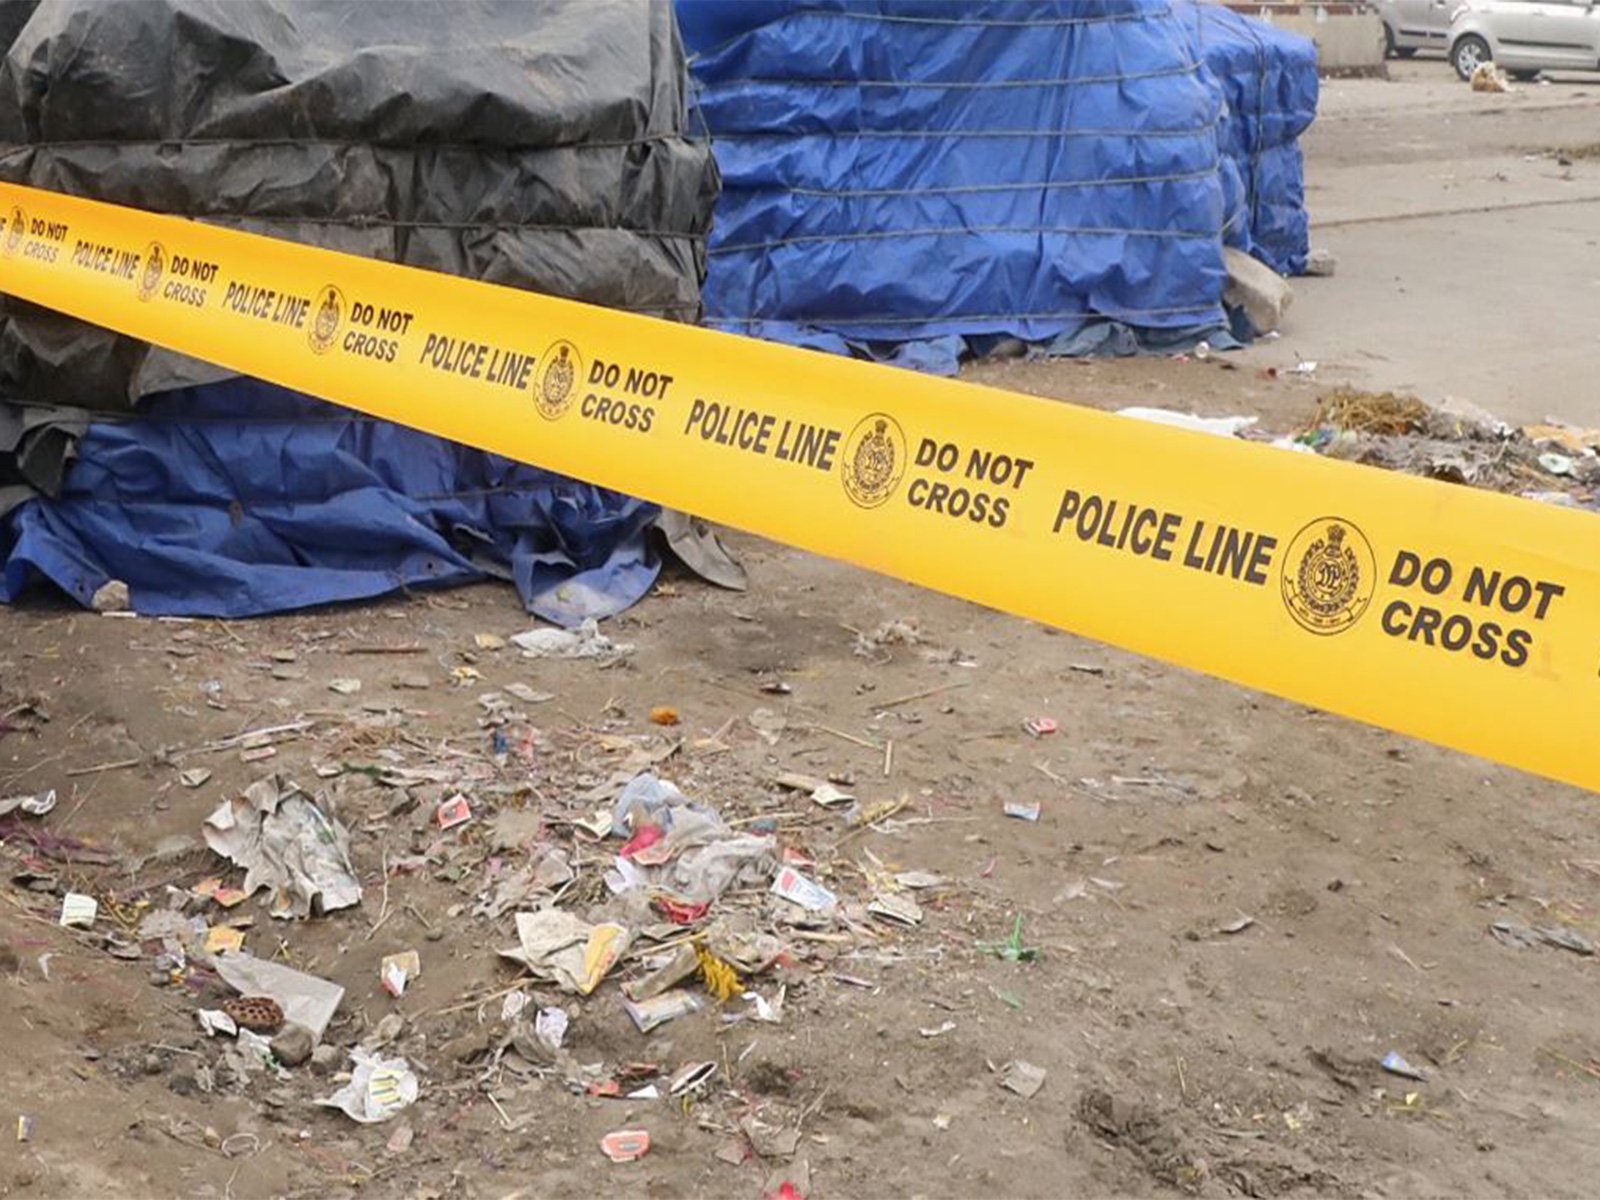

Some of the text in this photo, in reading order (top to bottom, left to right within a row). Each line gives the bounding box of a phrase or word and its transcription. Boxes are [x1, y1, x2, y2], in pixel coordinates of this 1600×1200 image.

[31, 218, 68, 241] DO NOT
[24, 239, 58, 264] CROSS
[72, 240, 141, 280] POLICE LINE
[170, 256, 219, 284] DO NOT
[163, 280, 207, 307] CROSS
[222, 281, 311, 328] POLICE LINE
[351, 302, 414, 335] DO NOT
[343, 332, 399, 363] CROSS
[420, 333, 535, 390] POLICE LINE
[588, 359, 675, 399] DO NOT
[581, 394, 655, 433] CROSS
[685, 399, 841, 471] POLICE LINE
[915, 438, 1034, 490] DO NOT
[907, 479, 1011, 528] CROSS
[1052, 489, 1278, 586] POLICE LINE
[1388, 549, 1565, 620] DO NOT
[1380, 600, 1534, 668] CROSS
